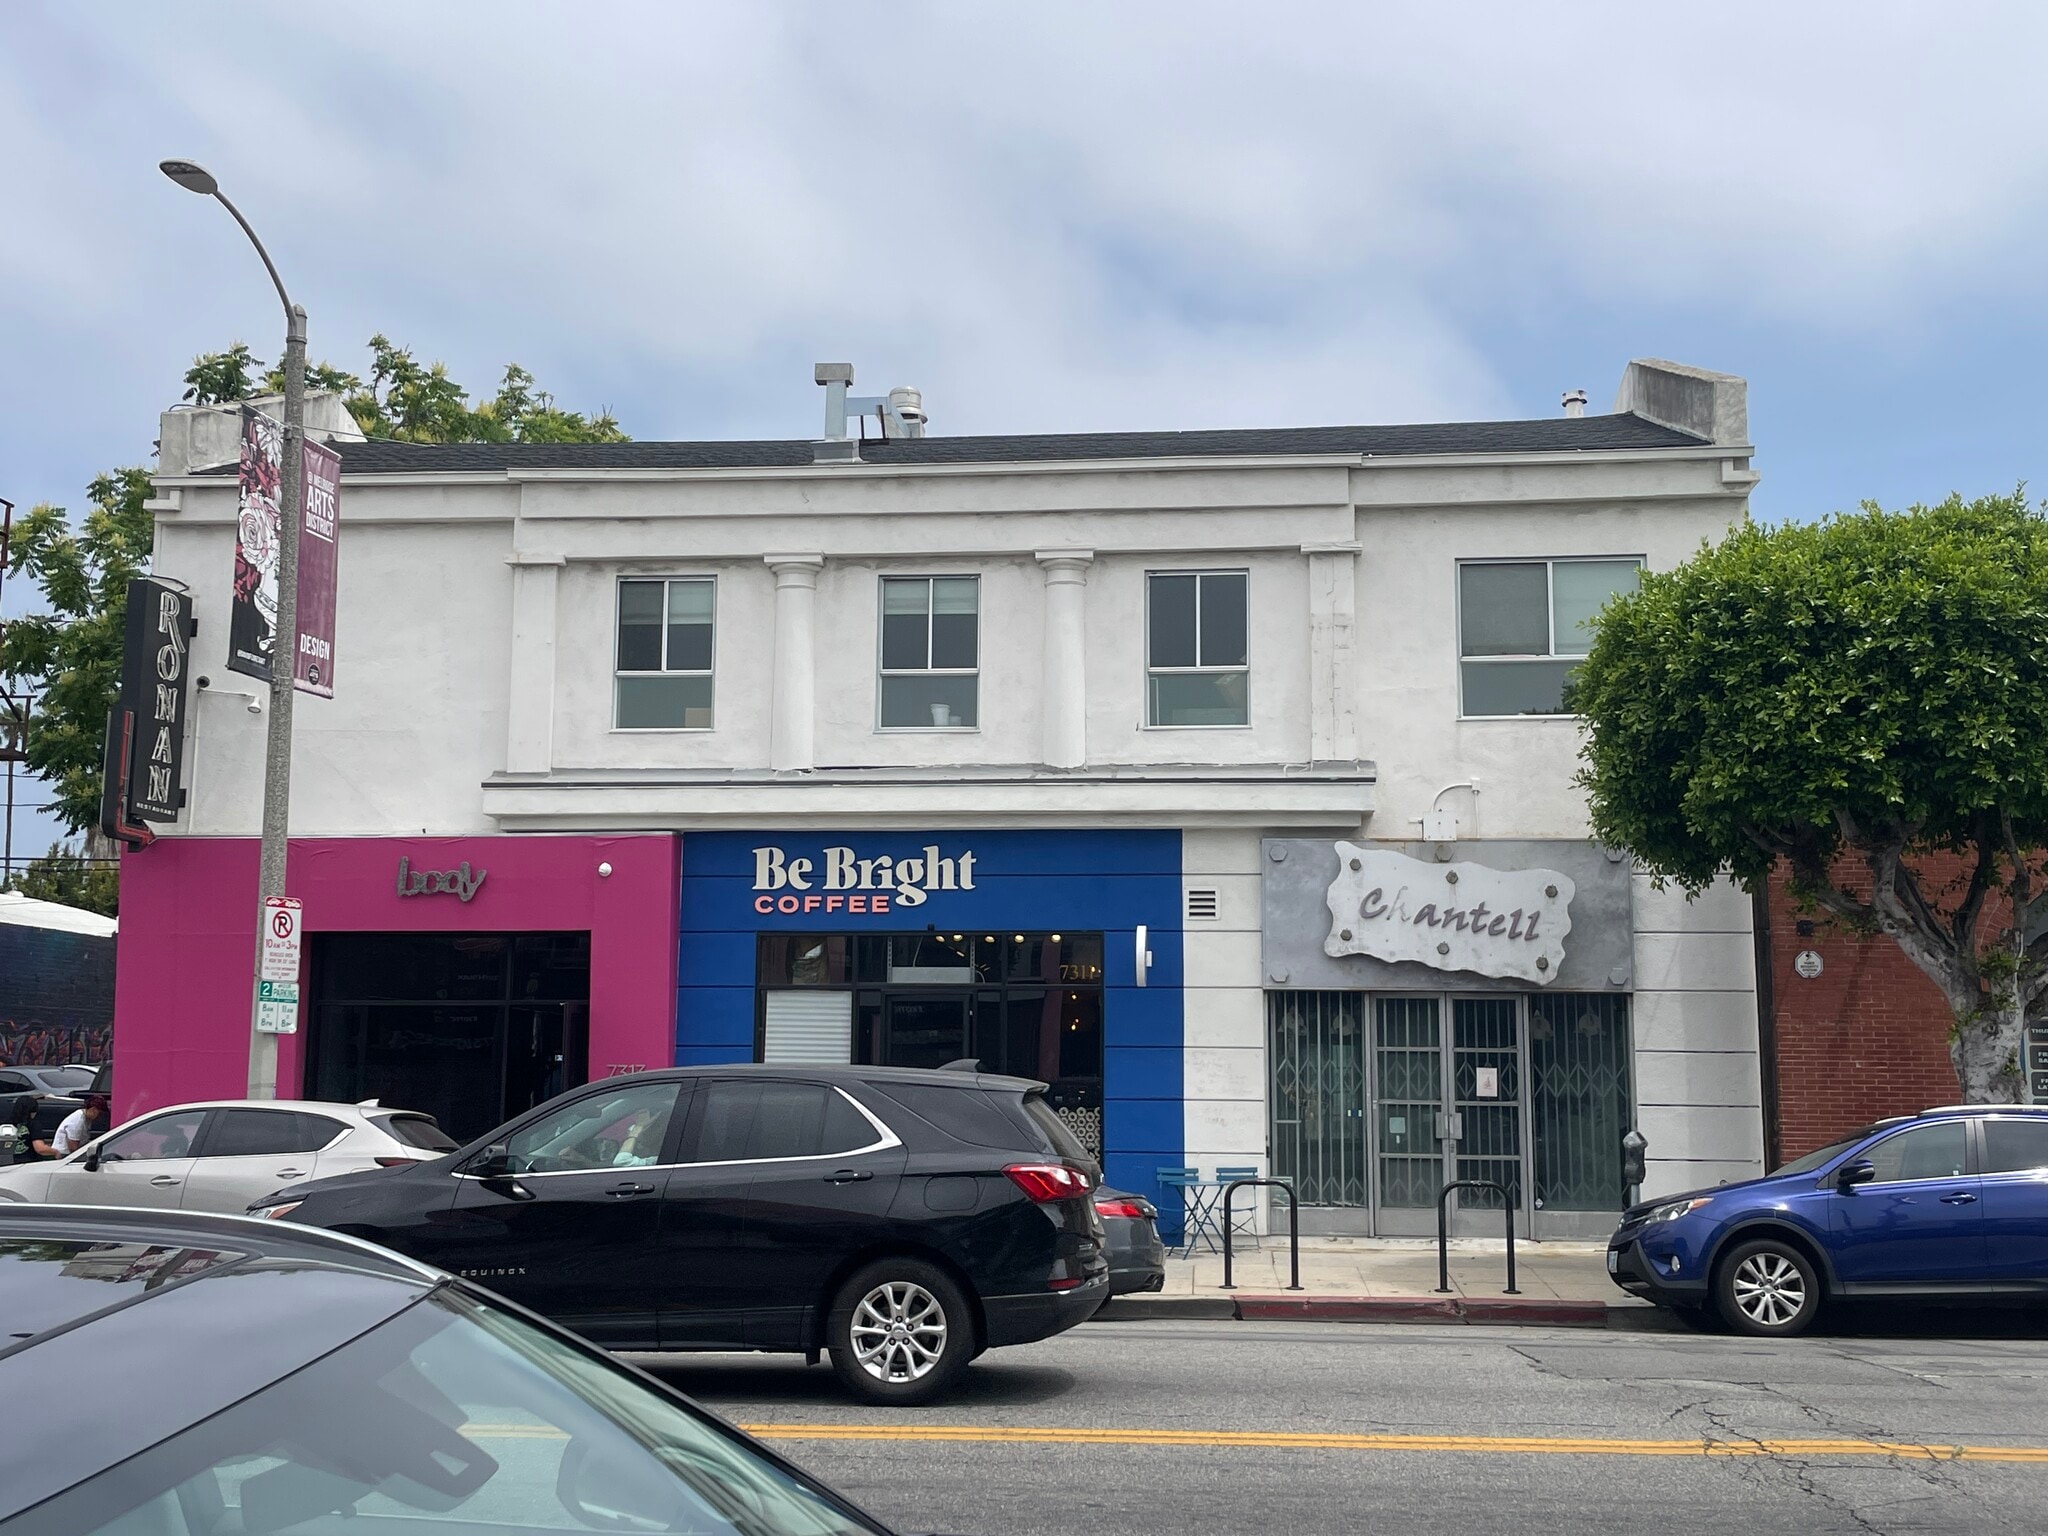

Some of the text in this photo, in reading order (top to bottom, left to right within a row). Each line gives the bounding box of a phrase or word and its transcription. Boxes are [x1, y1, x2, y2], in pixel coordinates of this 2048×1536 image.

[306, 484, 335, 521] ARTS
[305, 511, 334, 538] DISTRICT
[300, 633, 331, 661] DESIGN
[147, 591, 186, 803] RONAN
[752, 845, 977, 907] Be Bright
[754, 895, 891, 914] COFFEE
[1359, 884, 1541, 942] Chantell
[262, 982, 271, 996] 2
[273, 988, 297, 999] PARKING
[460, 1268, 526, 1276] EQUINOX
